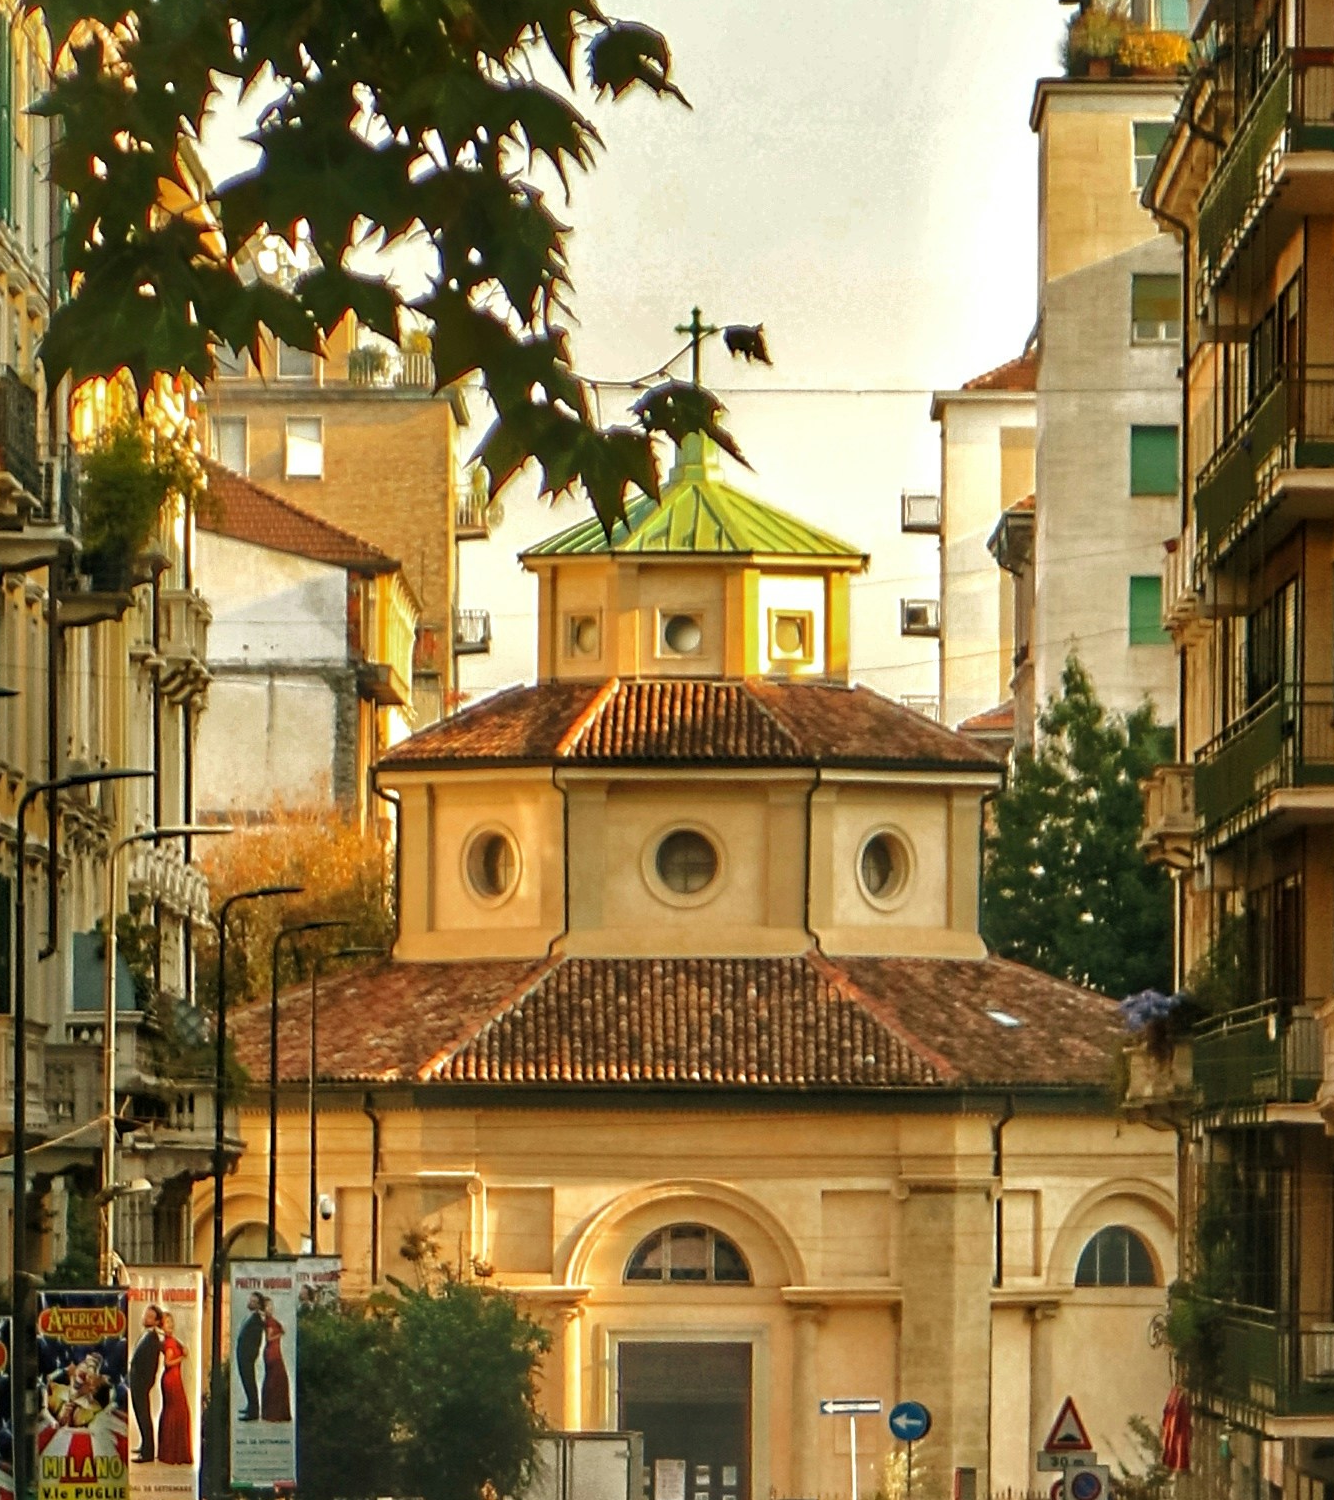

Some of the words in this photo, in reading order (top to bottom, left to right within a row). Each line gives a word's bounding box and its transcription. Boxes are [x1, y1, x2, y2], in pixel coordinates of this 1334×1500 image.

[47, 1306, 117, 1332] AMERICAN
[66, 1328, 99, 1339] CIRCUS
[42, 1455, 124, 1480] MILANO
[75, 1487, 126, 1499] PUGLIE
